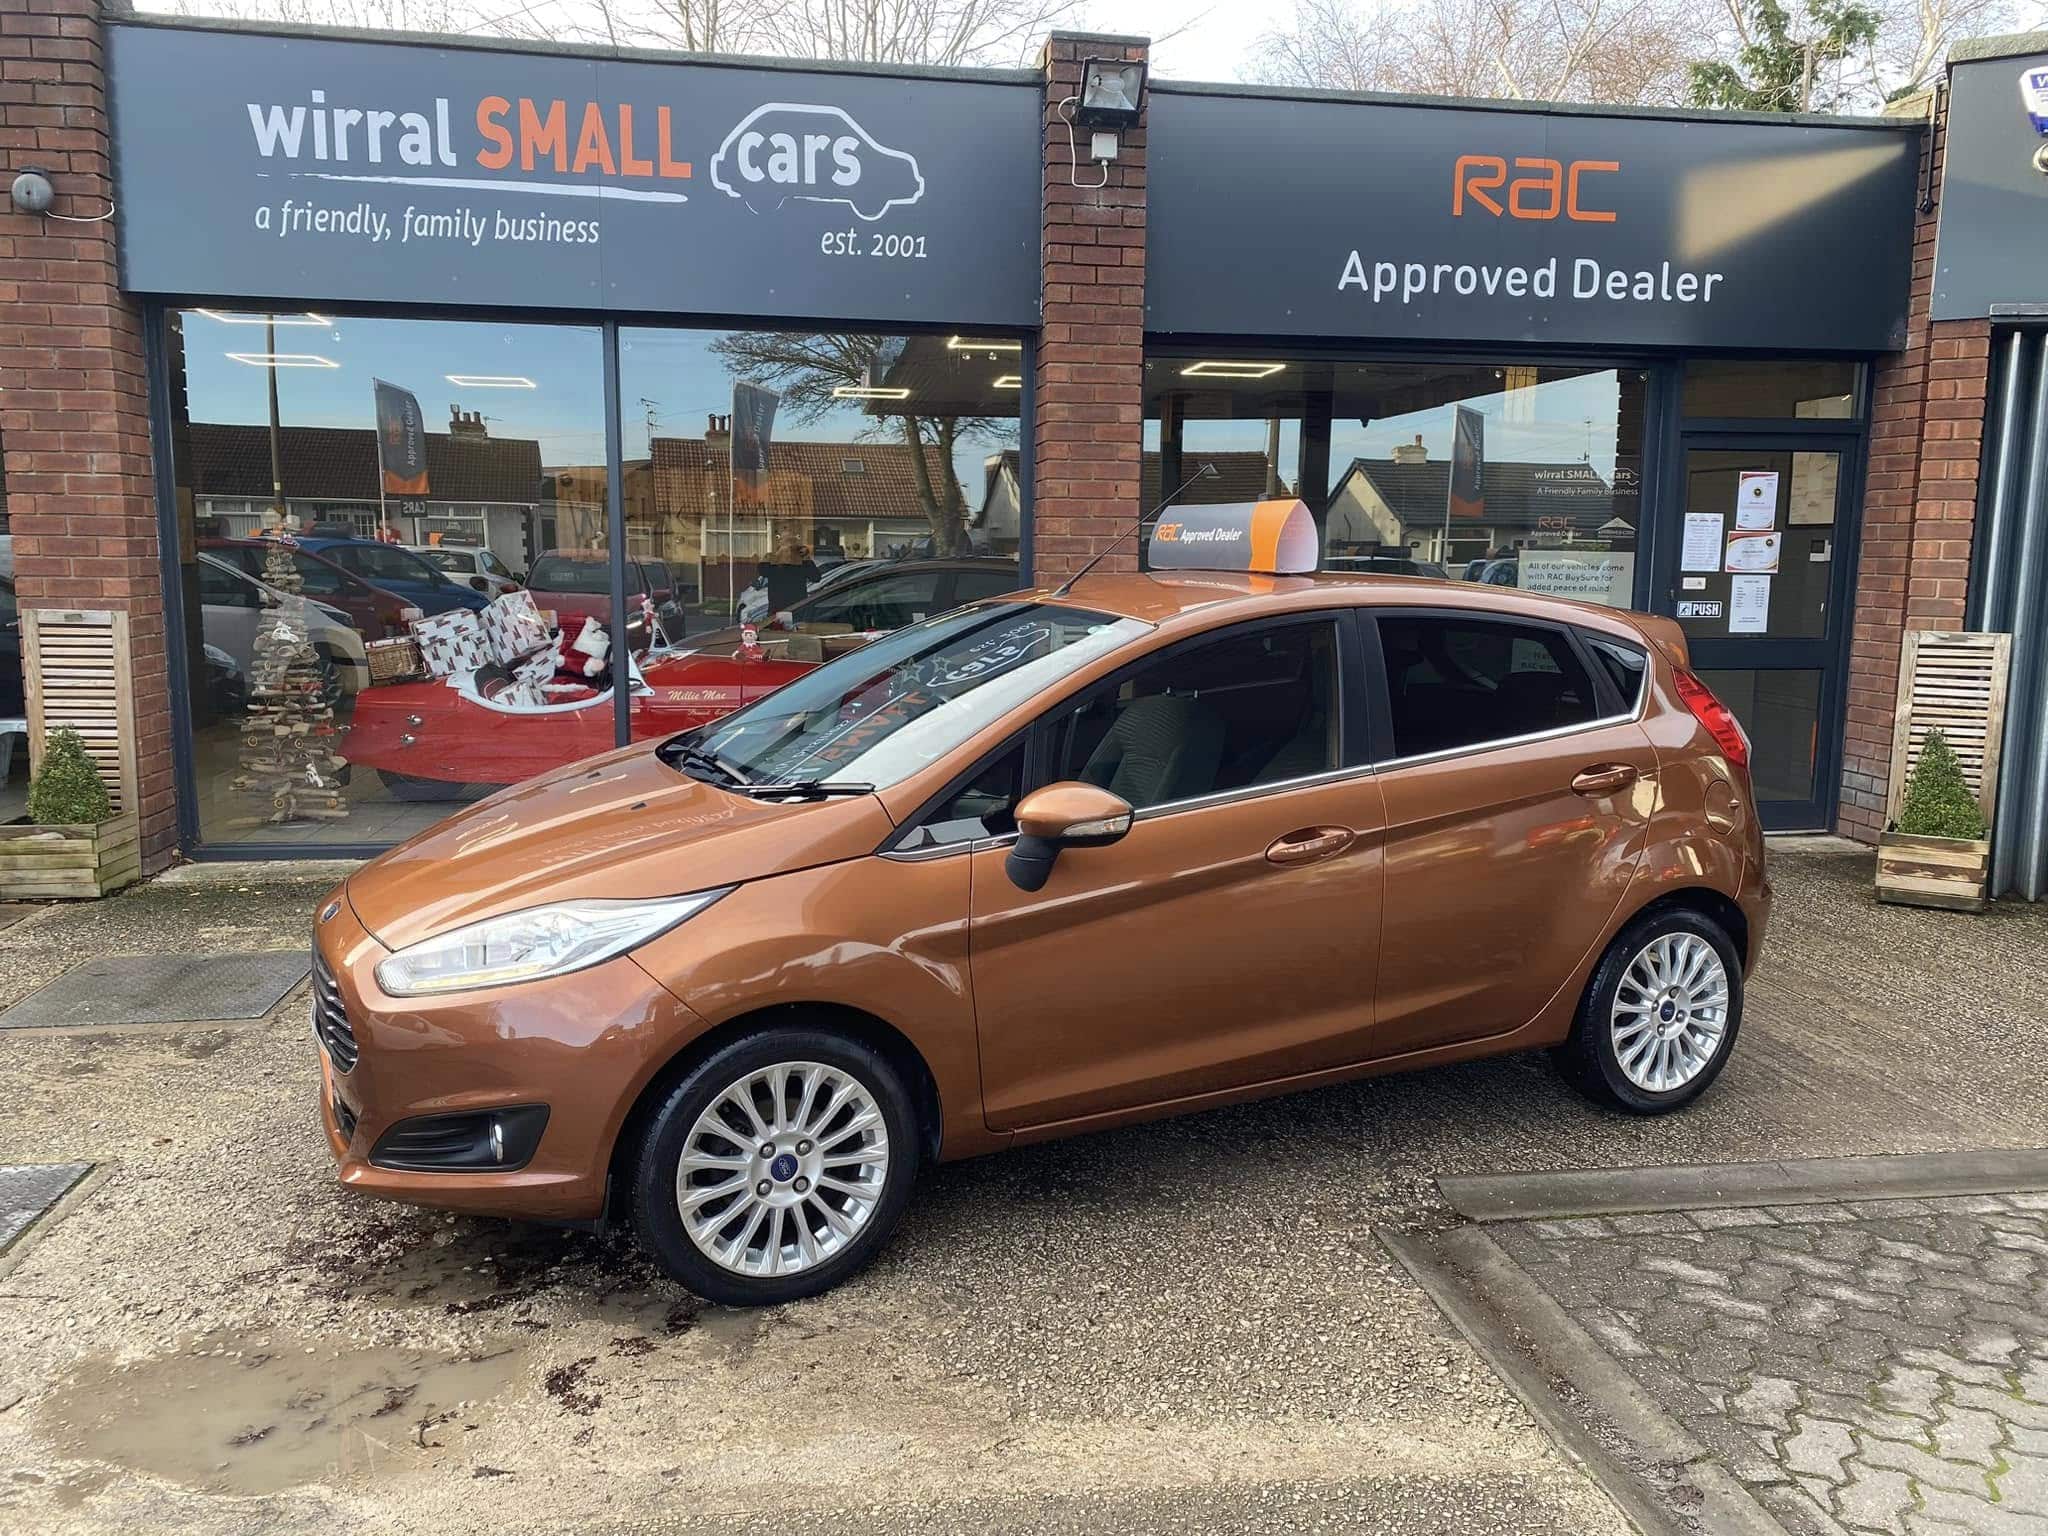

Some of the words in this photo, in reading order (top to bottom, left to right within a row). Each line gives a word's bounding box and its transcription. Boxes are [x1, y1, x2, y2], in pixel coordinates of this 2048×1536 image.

[247, 89, 457, 167] wirral
[475, 95, 692, 178] SMALL
[737, 131, 861, 186] cars
[254, 205, 271, 231] a
[279, 199, 392, 243] friendly,
[400, 205, 487, 247] family
[493, 209, 600, 244] business
[820, 227, 862, 256] est.
[869, 233, 928, 258] 2001
[1337, 249, 1557, 304] Approved
[1572, 257, 1724, 303] Dealer
[1180, 528, 1216, 544] Approved
[1215, 528, 1242, 541] Dealer
[1528, 562, 1540, 570] All
[1541, 562, 1550, 570] of
[1566, 562, 1600, 571] vehicles
[1527, 572, 1547, 580] with
[1547, 572, 1563, 580] RAC
[1565, 573, 1600, 582] BuySure
[1526, 584, 1552, 592] added
[1553, 584, 1577, 593] peace
[1692, 603, 1720, 616] PUSH
